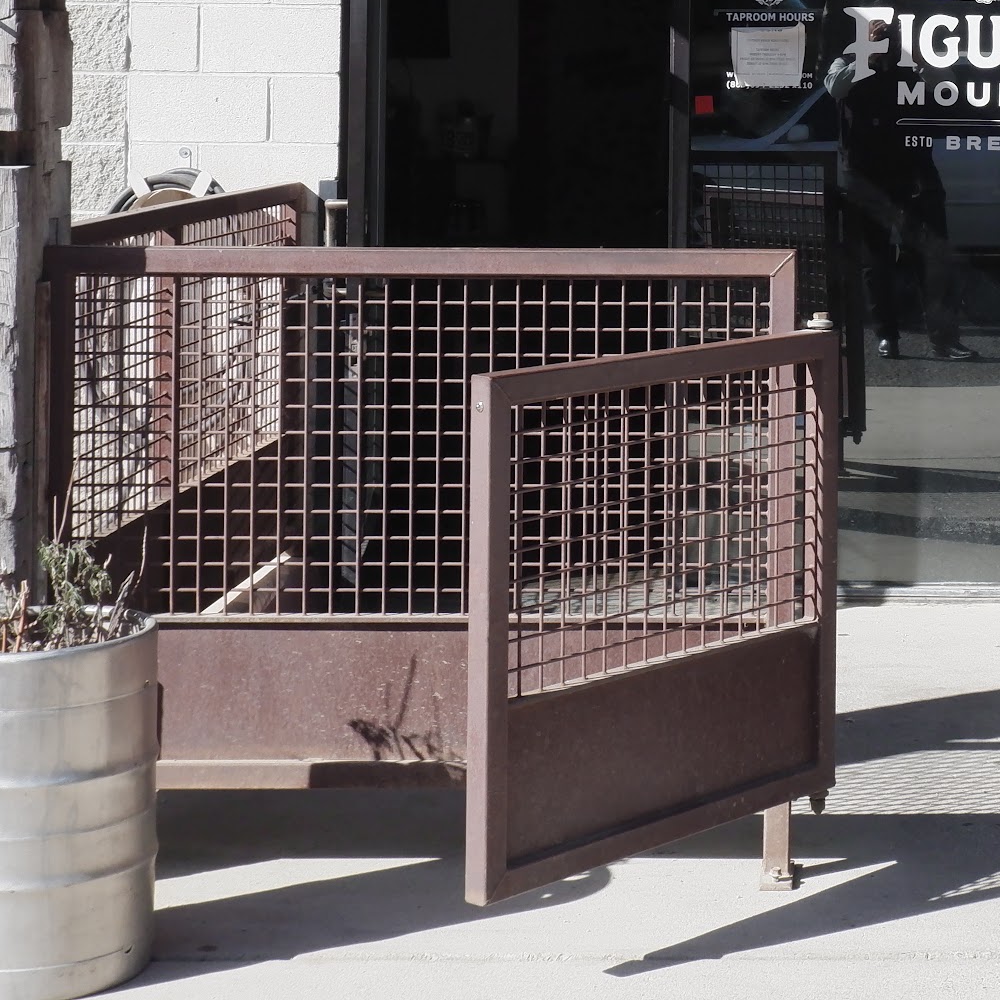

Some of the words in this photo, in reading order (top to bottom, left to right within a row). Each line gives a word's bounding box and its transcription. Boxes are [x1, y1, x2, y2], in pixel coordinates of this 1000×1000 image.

[726, 12, 776, 22] TAPROOM
[780, 12, 815, 22] HOURS
[905, 136, 933, 148] ESTD
